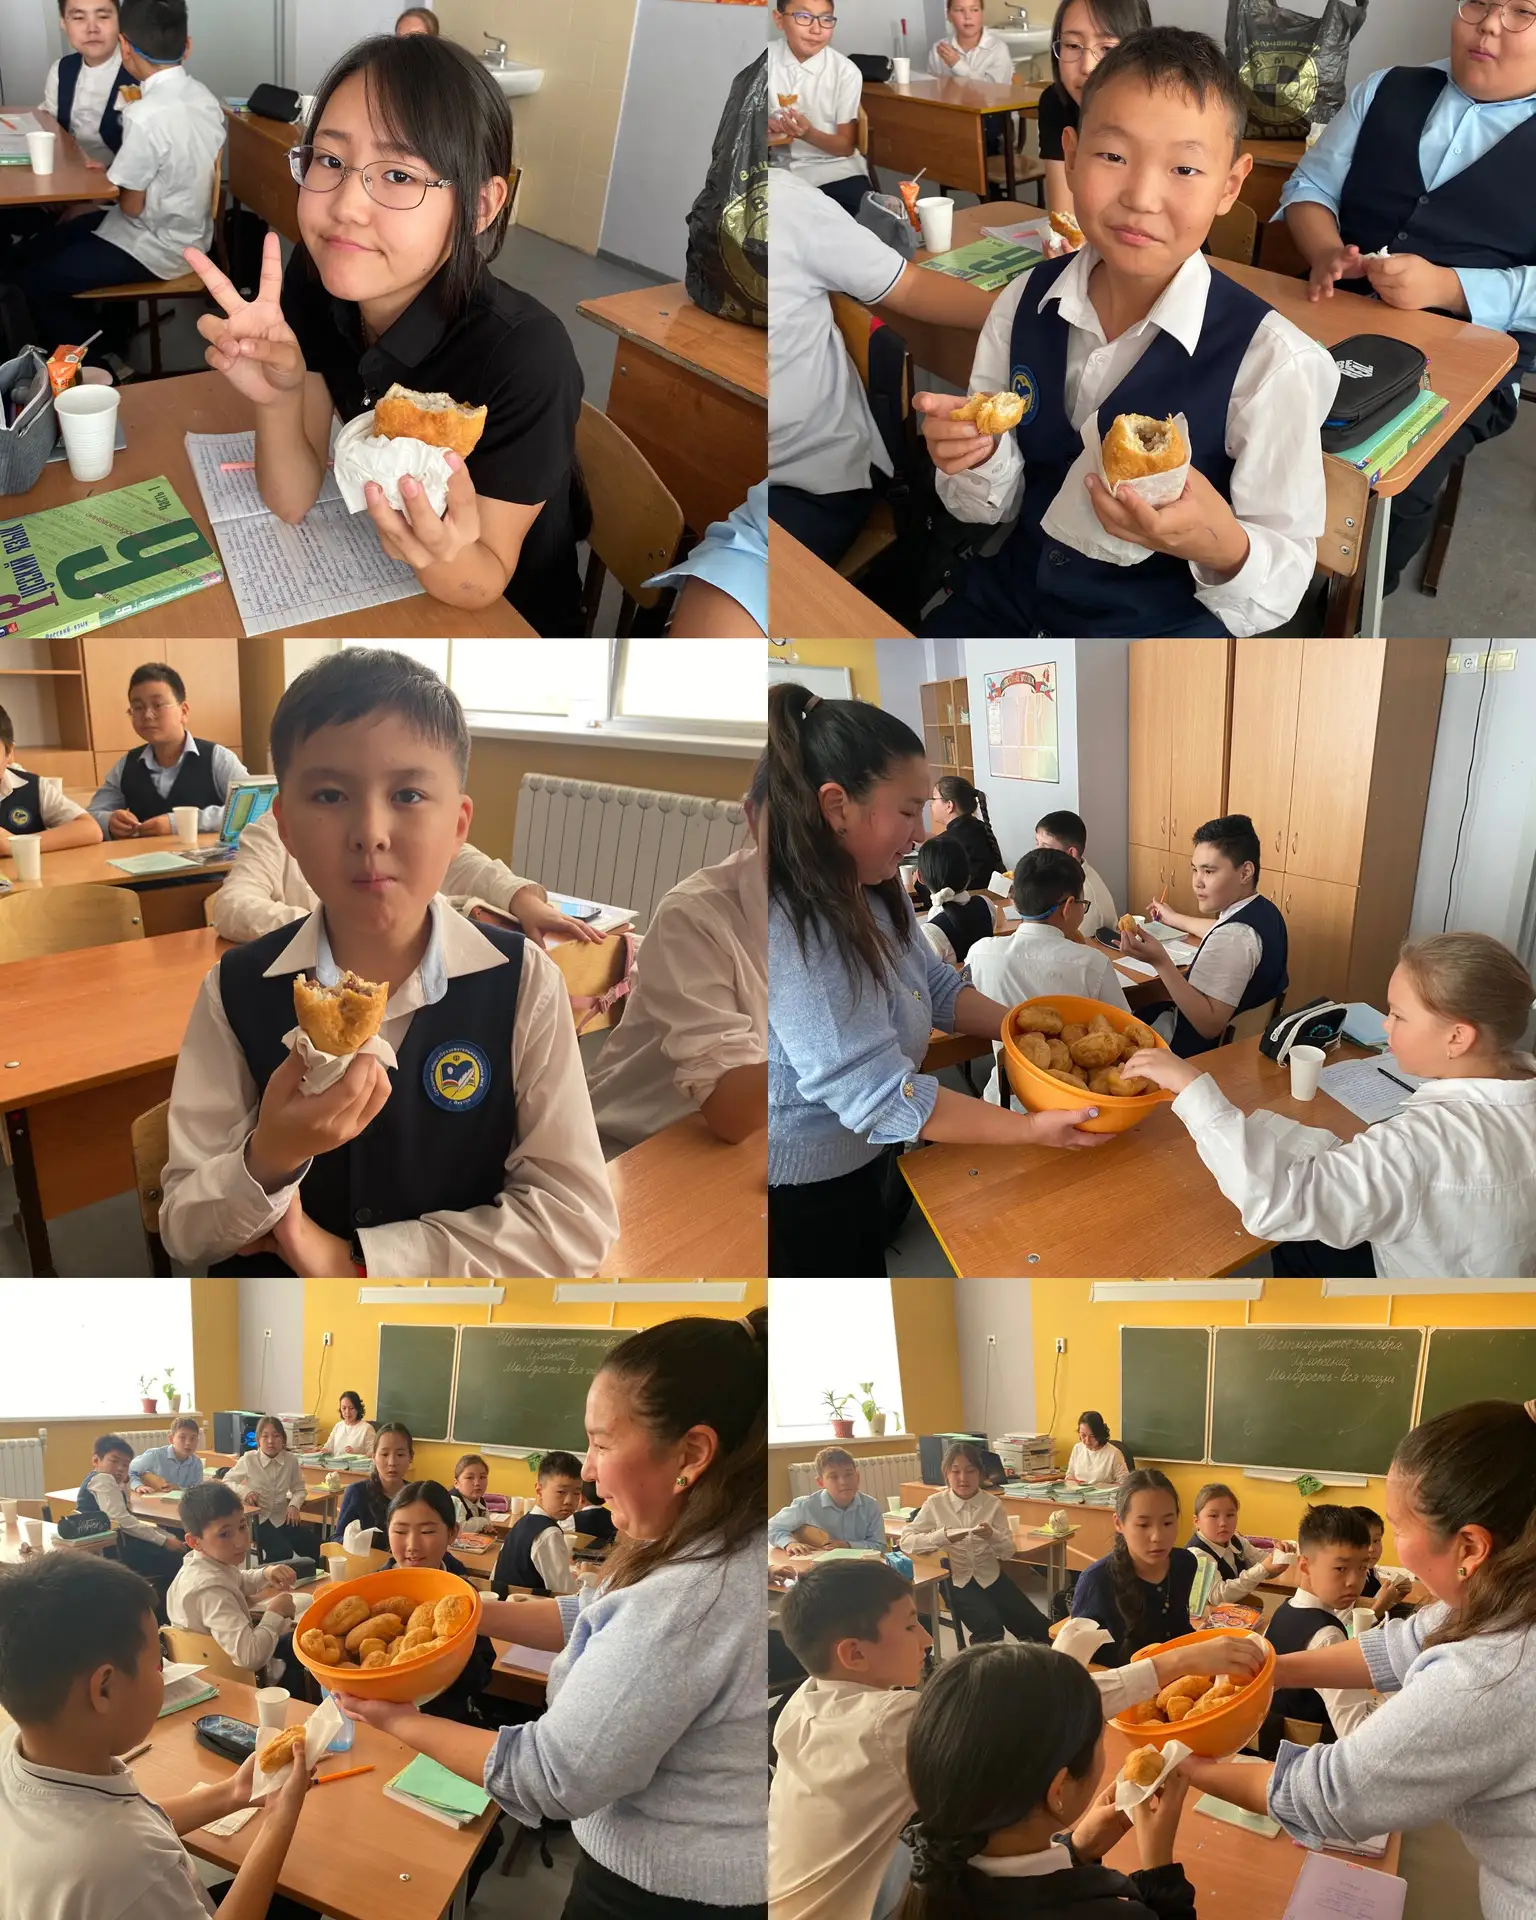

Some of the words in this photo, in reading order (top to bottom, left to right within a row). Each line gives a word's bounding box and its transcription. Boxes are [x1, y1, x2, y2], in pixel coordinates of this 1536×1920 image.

[154, 490, 172, 511] Часть
[56, 517, 214, 600] 9
[1265, 1367, 1333, 1389] Молодость
[1361, 1373, 1396, 1389] жизнь
